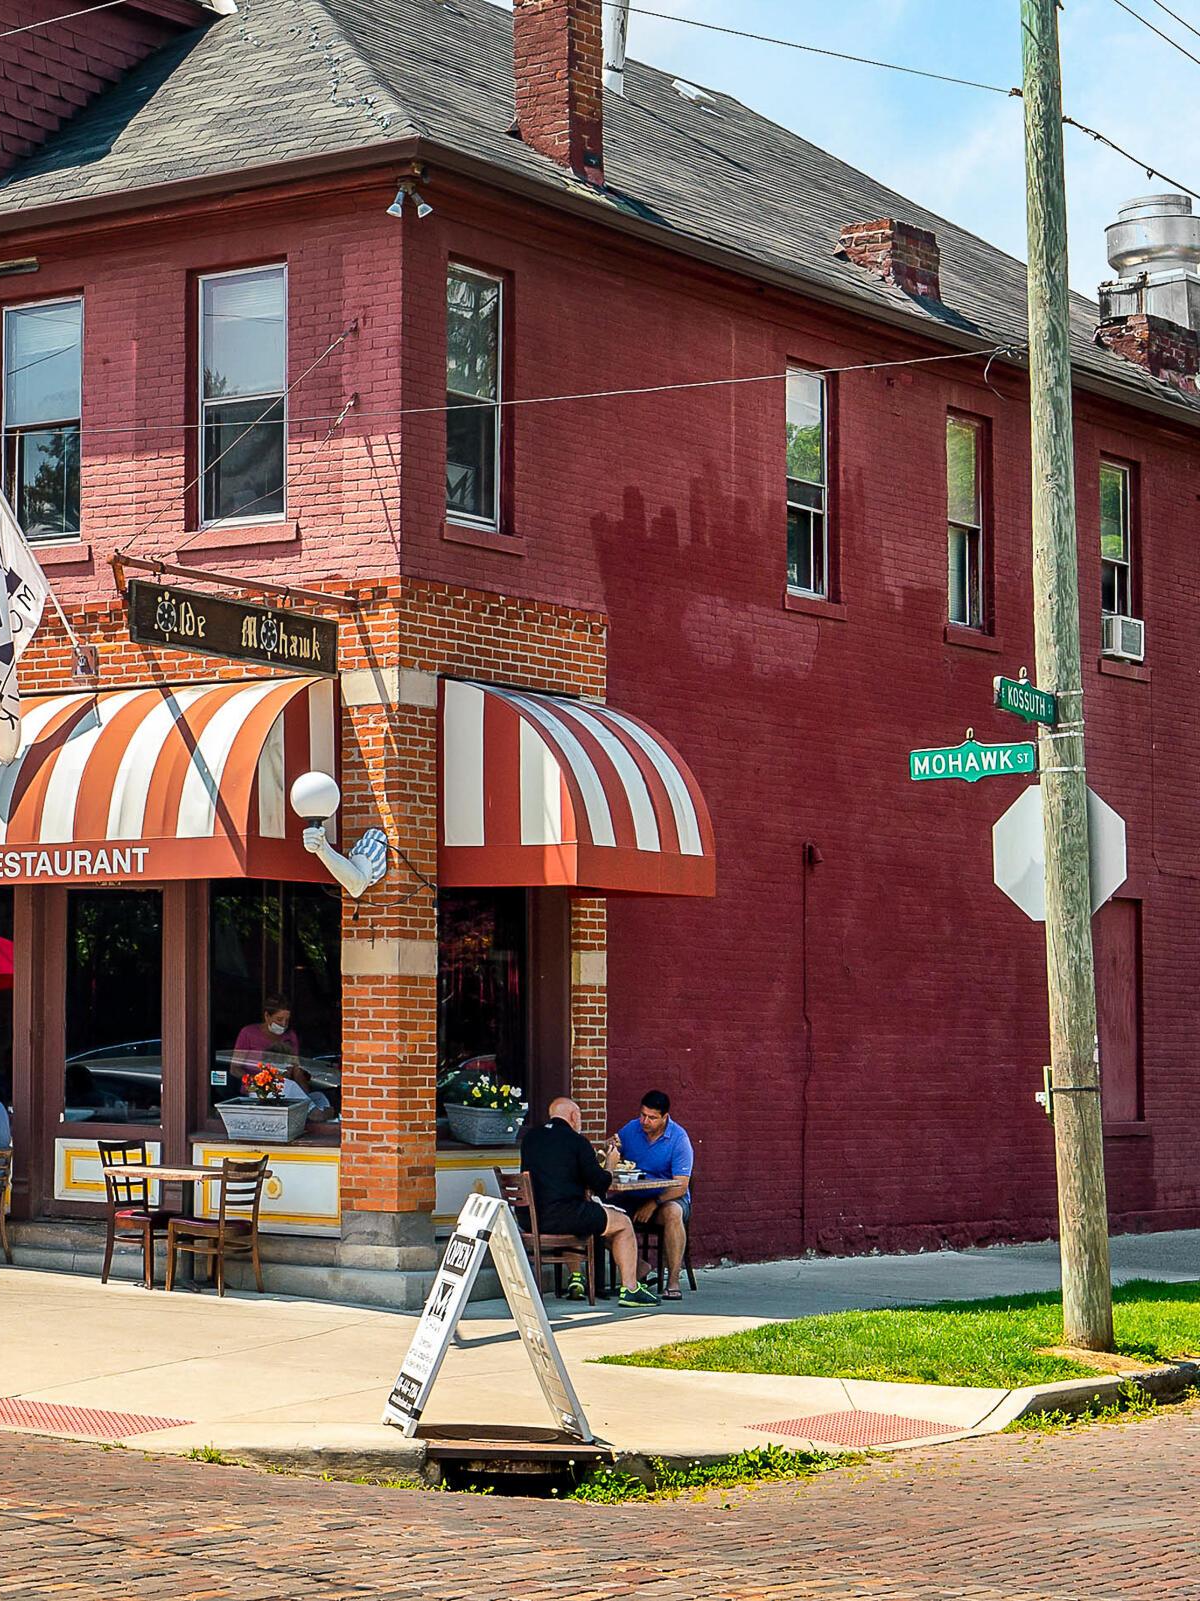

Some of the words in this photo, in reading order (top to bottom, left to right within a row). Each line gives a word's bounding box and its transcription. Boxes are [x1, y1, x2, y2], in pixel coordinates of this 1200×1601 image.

[154, 593, 206, 640] Olde
[1007, 685, 1046, 717] KOSSUTH
[913, 750, 1014, 776] MOHAWK
[1016, 752, 1029, 764] ST
[445, 1241, 474, 1269] OPEN
